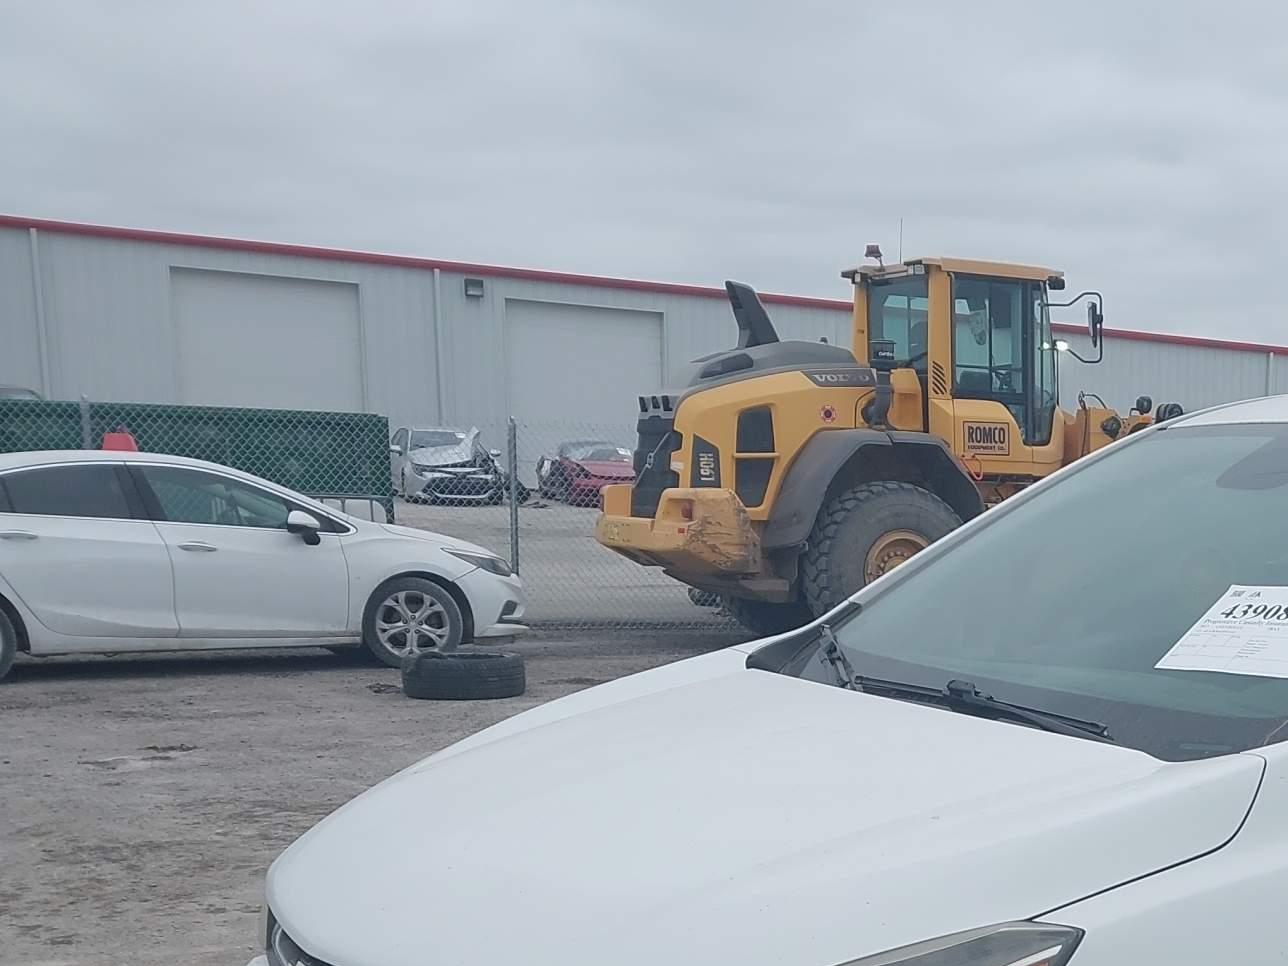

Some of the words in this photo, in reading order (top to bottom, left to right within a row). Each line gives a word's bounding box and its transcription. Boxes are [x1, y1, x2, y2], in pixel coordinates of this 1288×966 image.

[812, 373, 870, 383] VOLO
[967, 425, 1006, 444] ROMCO
[699, 453, 715, 481] L90H
